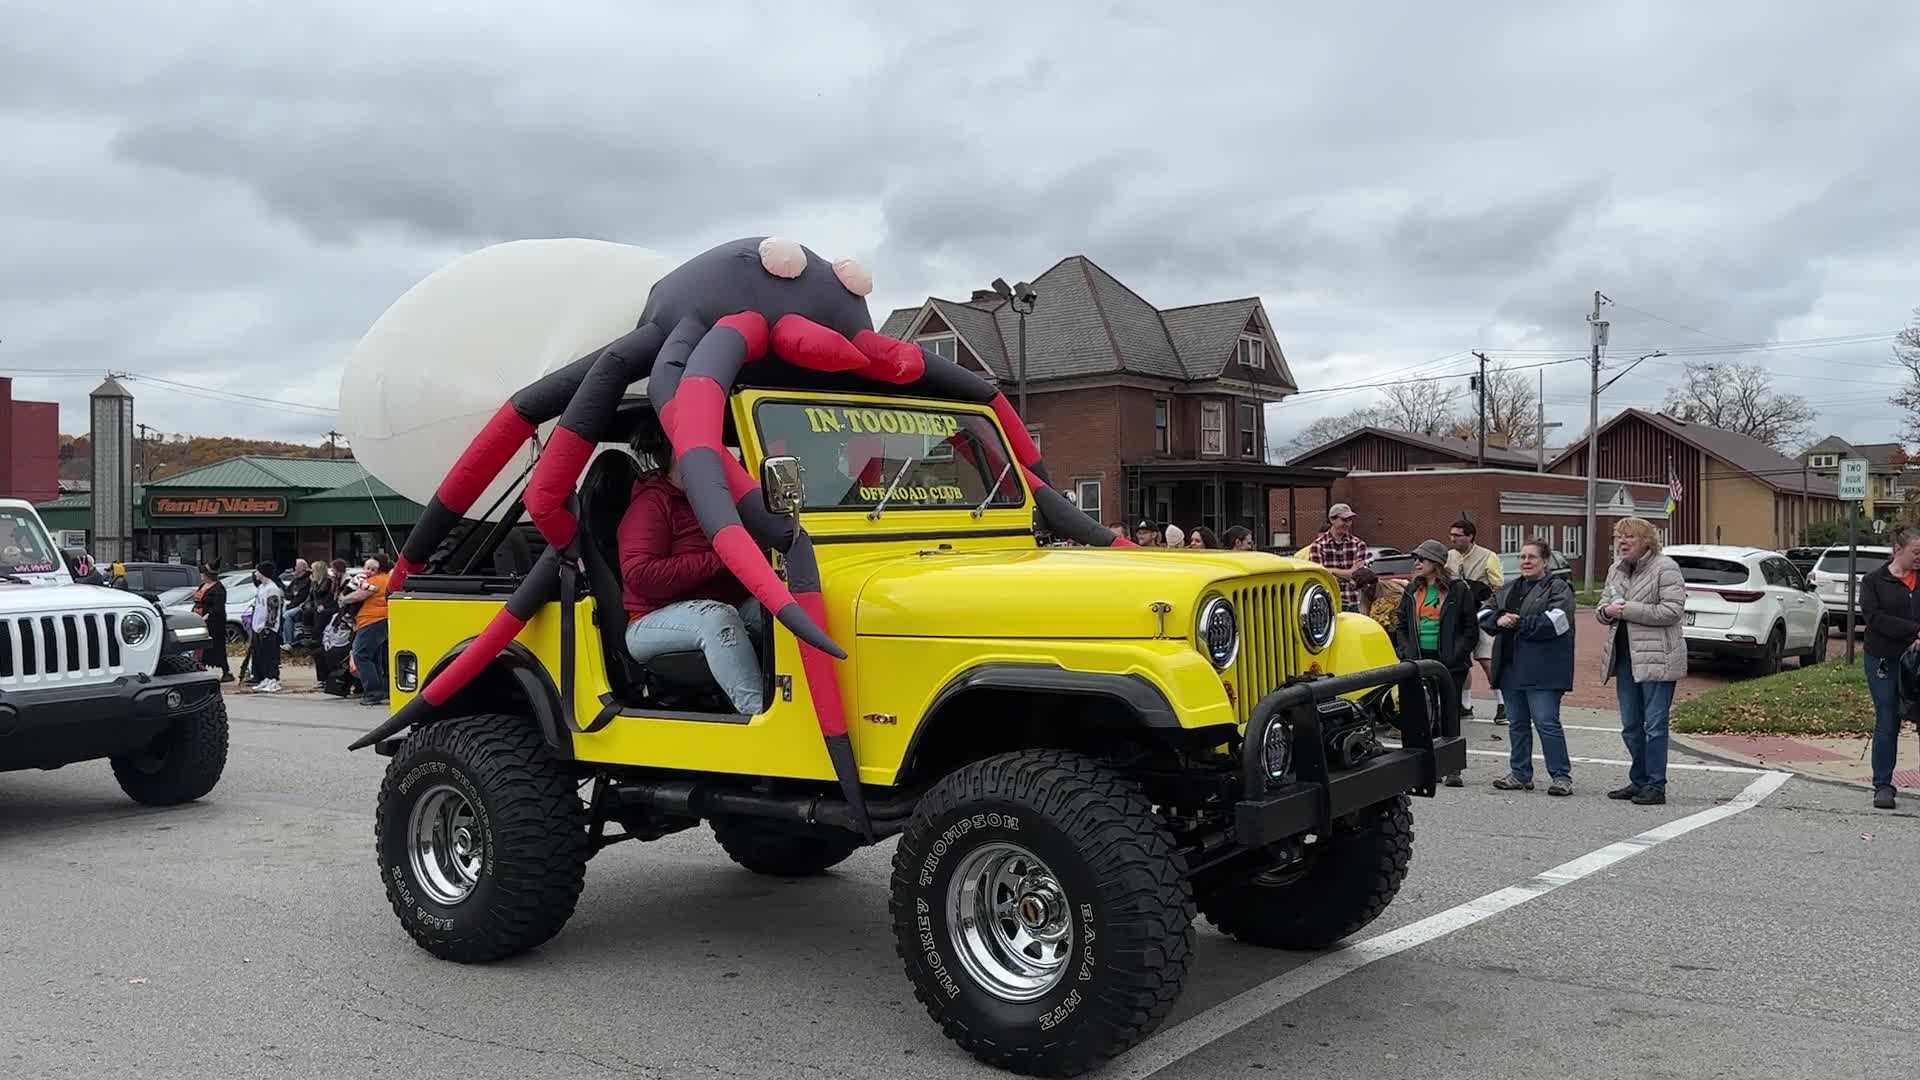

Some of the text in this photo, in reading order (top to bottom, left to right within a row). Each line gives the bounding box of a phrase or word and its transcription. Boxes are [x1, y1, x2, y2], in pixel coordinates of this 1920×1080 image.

[805, 407, 840, 433] IN
[1847, 464, 1861, 472] TWO
[216, 498, 280, 512] Video
[860, 486, 885, 500] OFF
[930, 486, 963, 500] CLUB
[398, 761, 447, 795] MICKEY
[917, 813, 1020, 999] MICKEY THOMPSON
[1039, 904, 1096, 1031] BAJA MTZ
